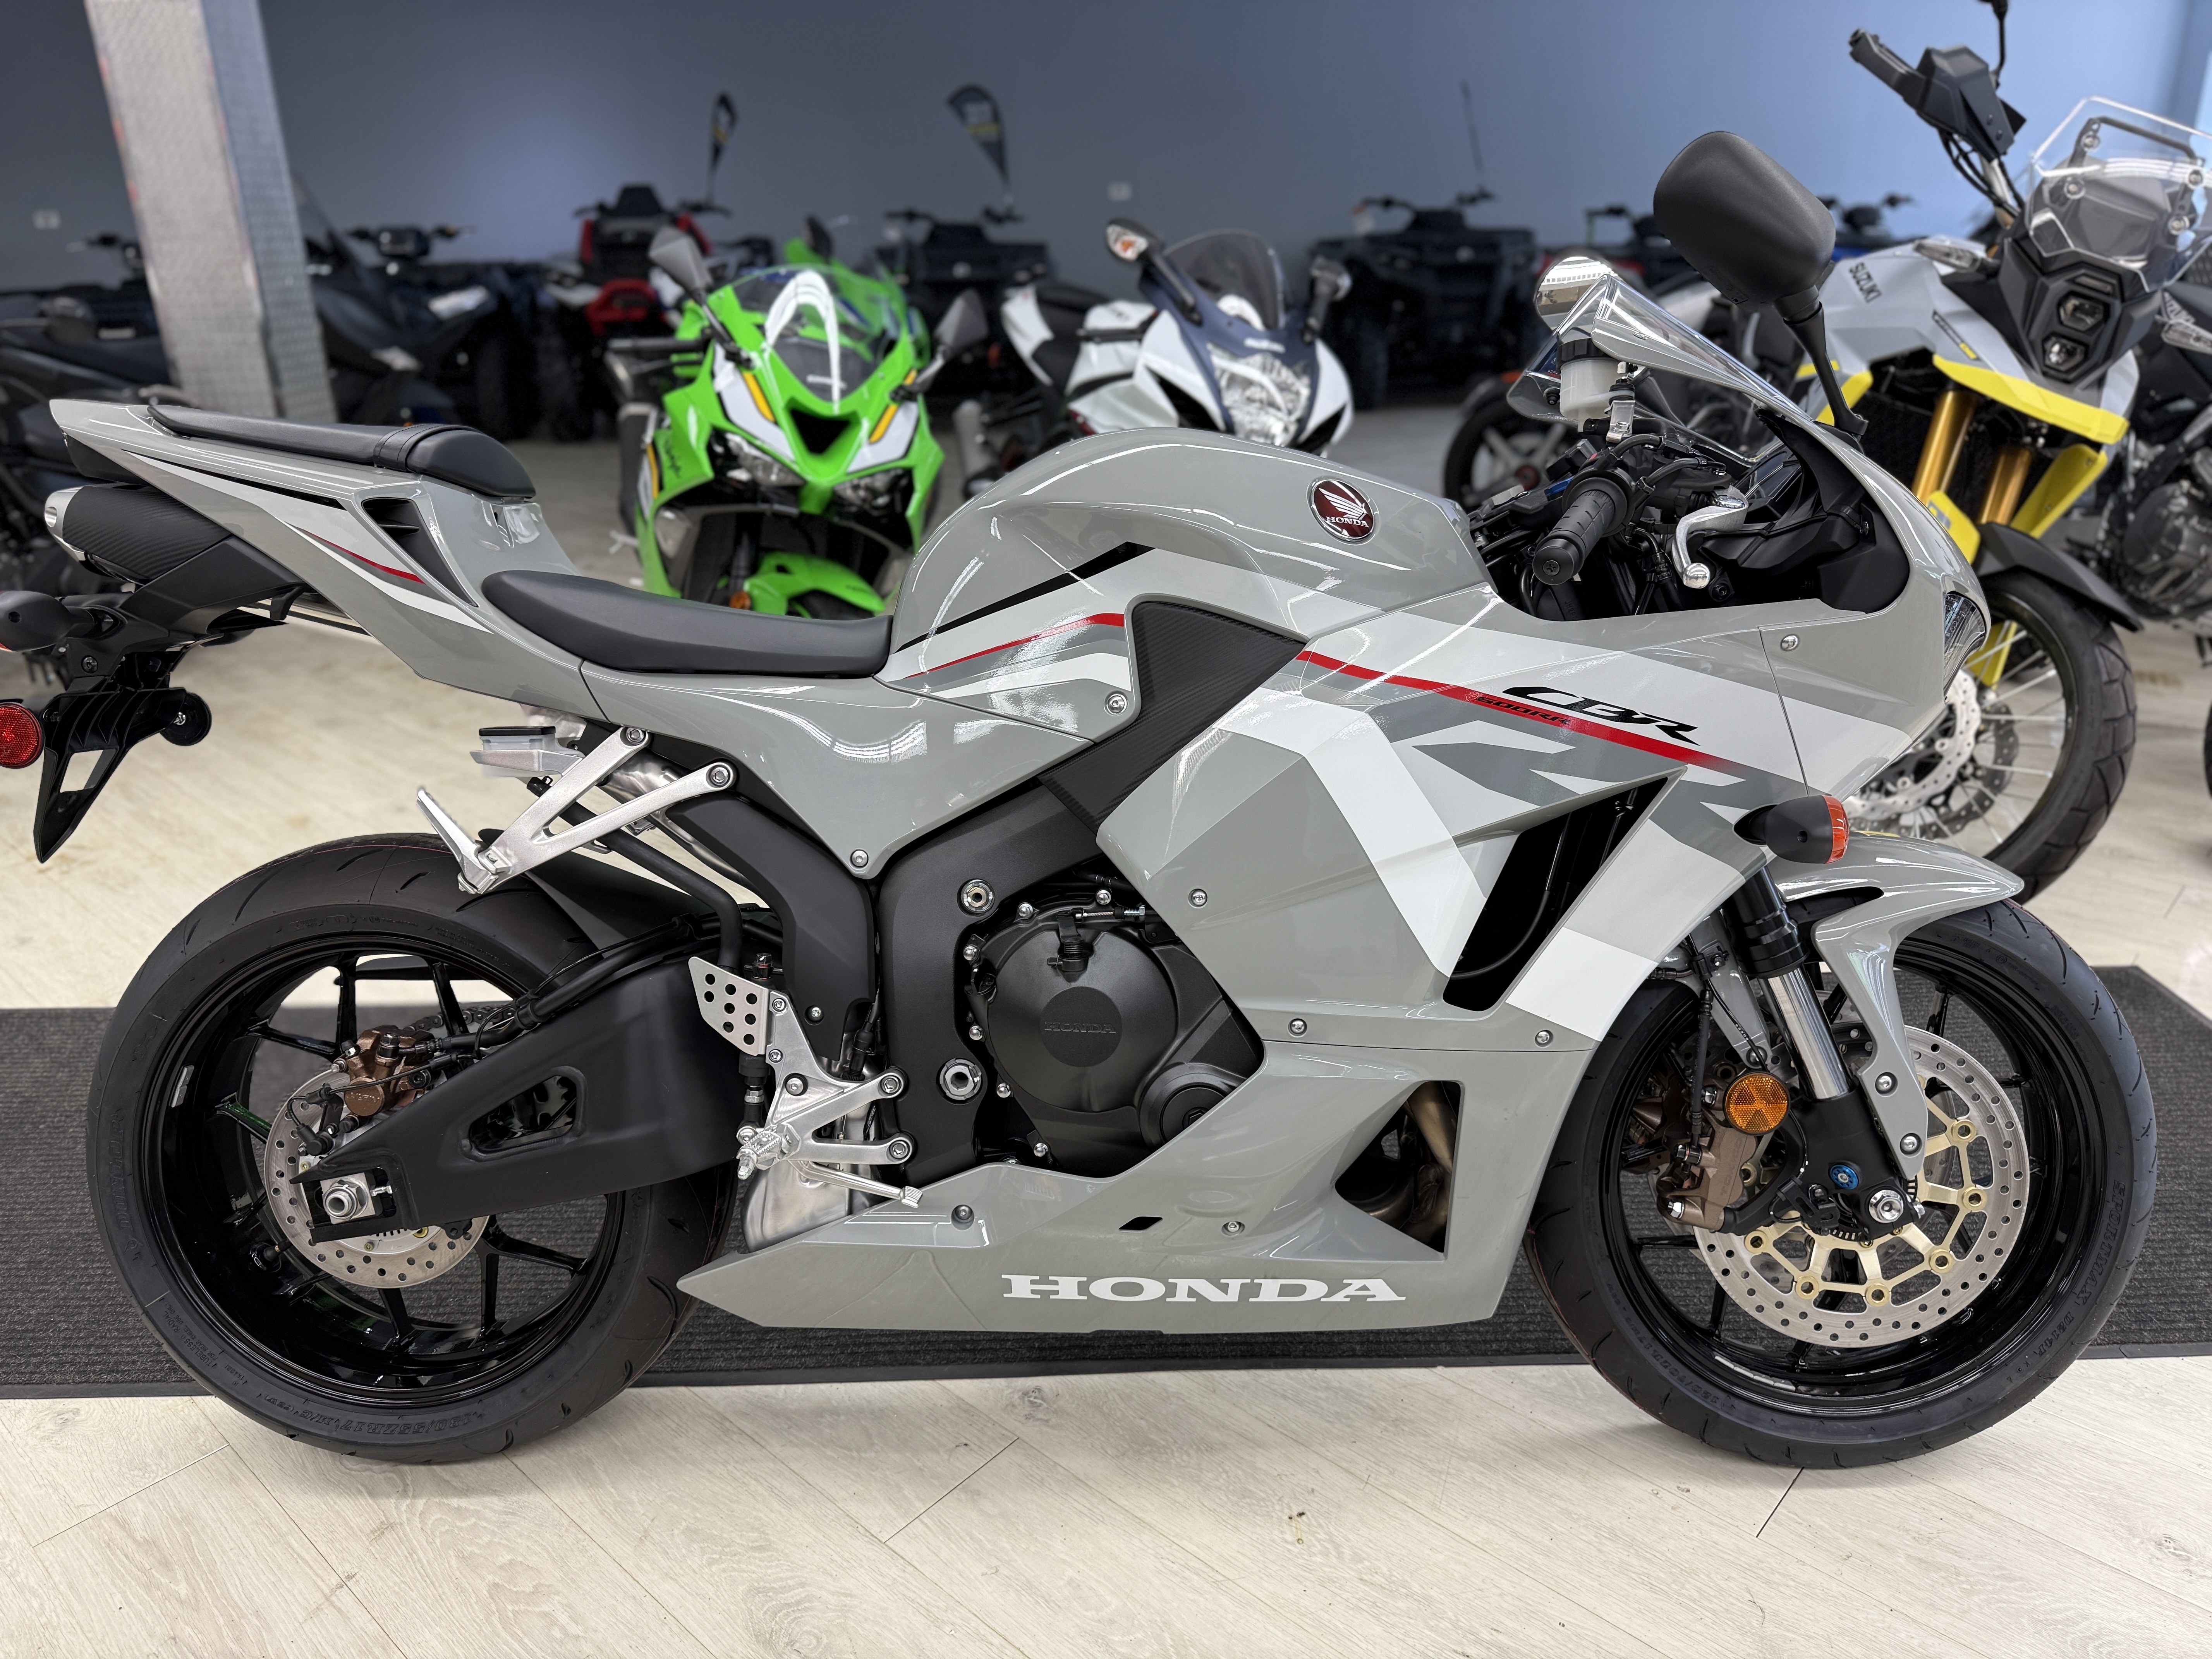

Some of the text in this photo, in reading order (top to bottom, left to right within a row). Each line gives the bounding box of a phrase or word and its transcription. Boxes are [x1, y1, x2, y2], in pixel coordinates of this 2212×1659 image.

[1849, 262, 1882, 303] SUZUKI
[1325, 516, 1369, 528] HONDA
[1475, 696, 1571, 726] 600RR
[1502, 686, 1701, 746] CBR
[1044, 1022, 1116, 1034] HONDA
[108, 1118, 132, 1232] DUNLOP
[2077, 1181, 2125, 1305] SPORTMAX
[1001, 1274, 1406, 1302] HONDA
[162, 1310, 180, 1333] RADIAL
[2037, 1311, 2075, 1358] D214F
[183, 1338, 213, 1367] TUBELESS
[300, 1410, 334, 1426] M/C
[339, 1412, 472, 1435] 180/55ZR17
